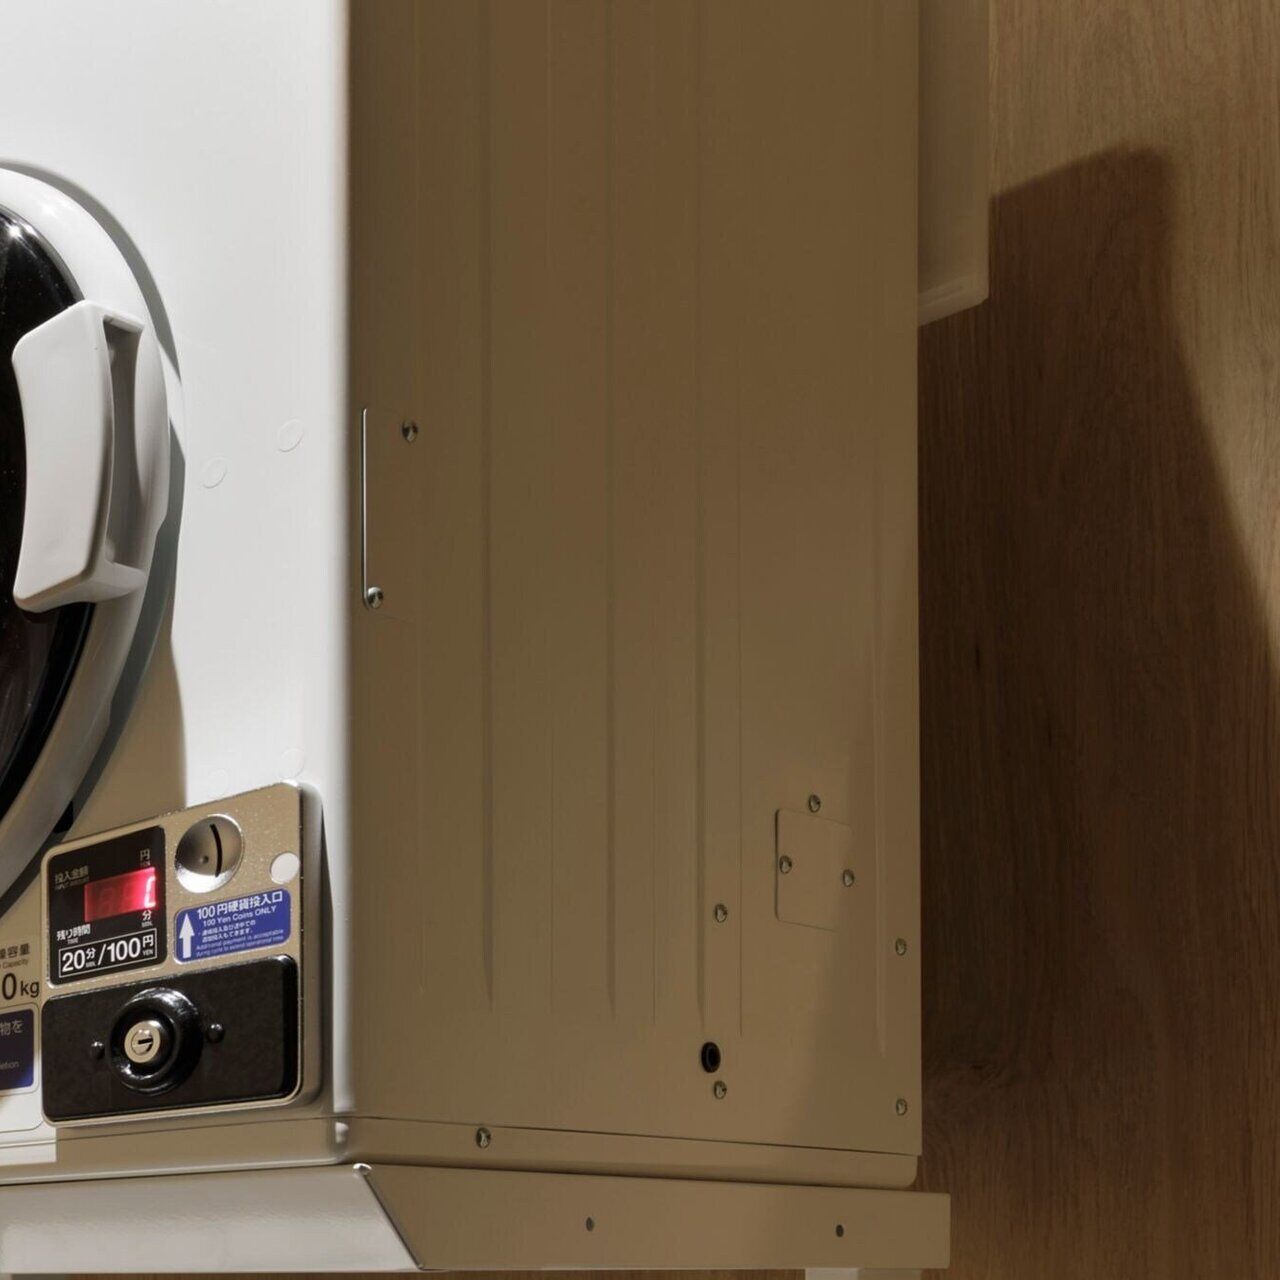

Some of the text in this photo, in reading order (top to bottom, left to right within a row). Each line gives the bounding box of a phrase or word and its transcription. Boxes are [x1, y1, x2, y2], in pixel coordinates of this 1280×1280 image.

[197, 891, 283, 920] 100円硬貨投入口
[255, 905, 277, 916] ONLY
